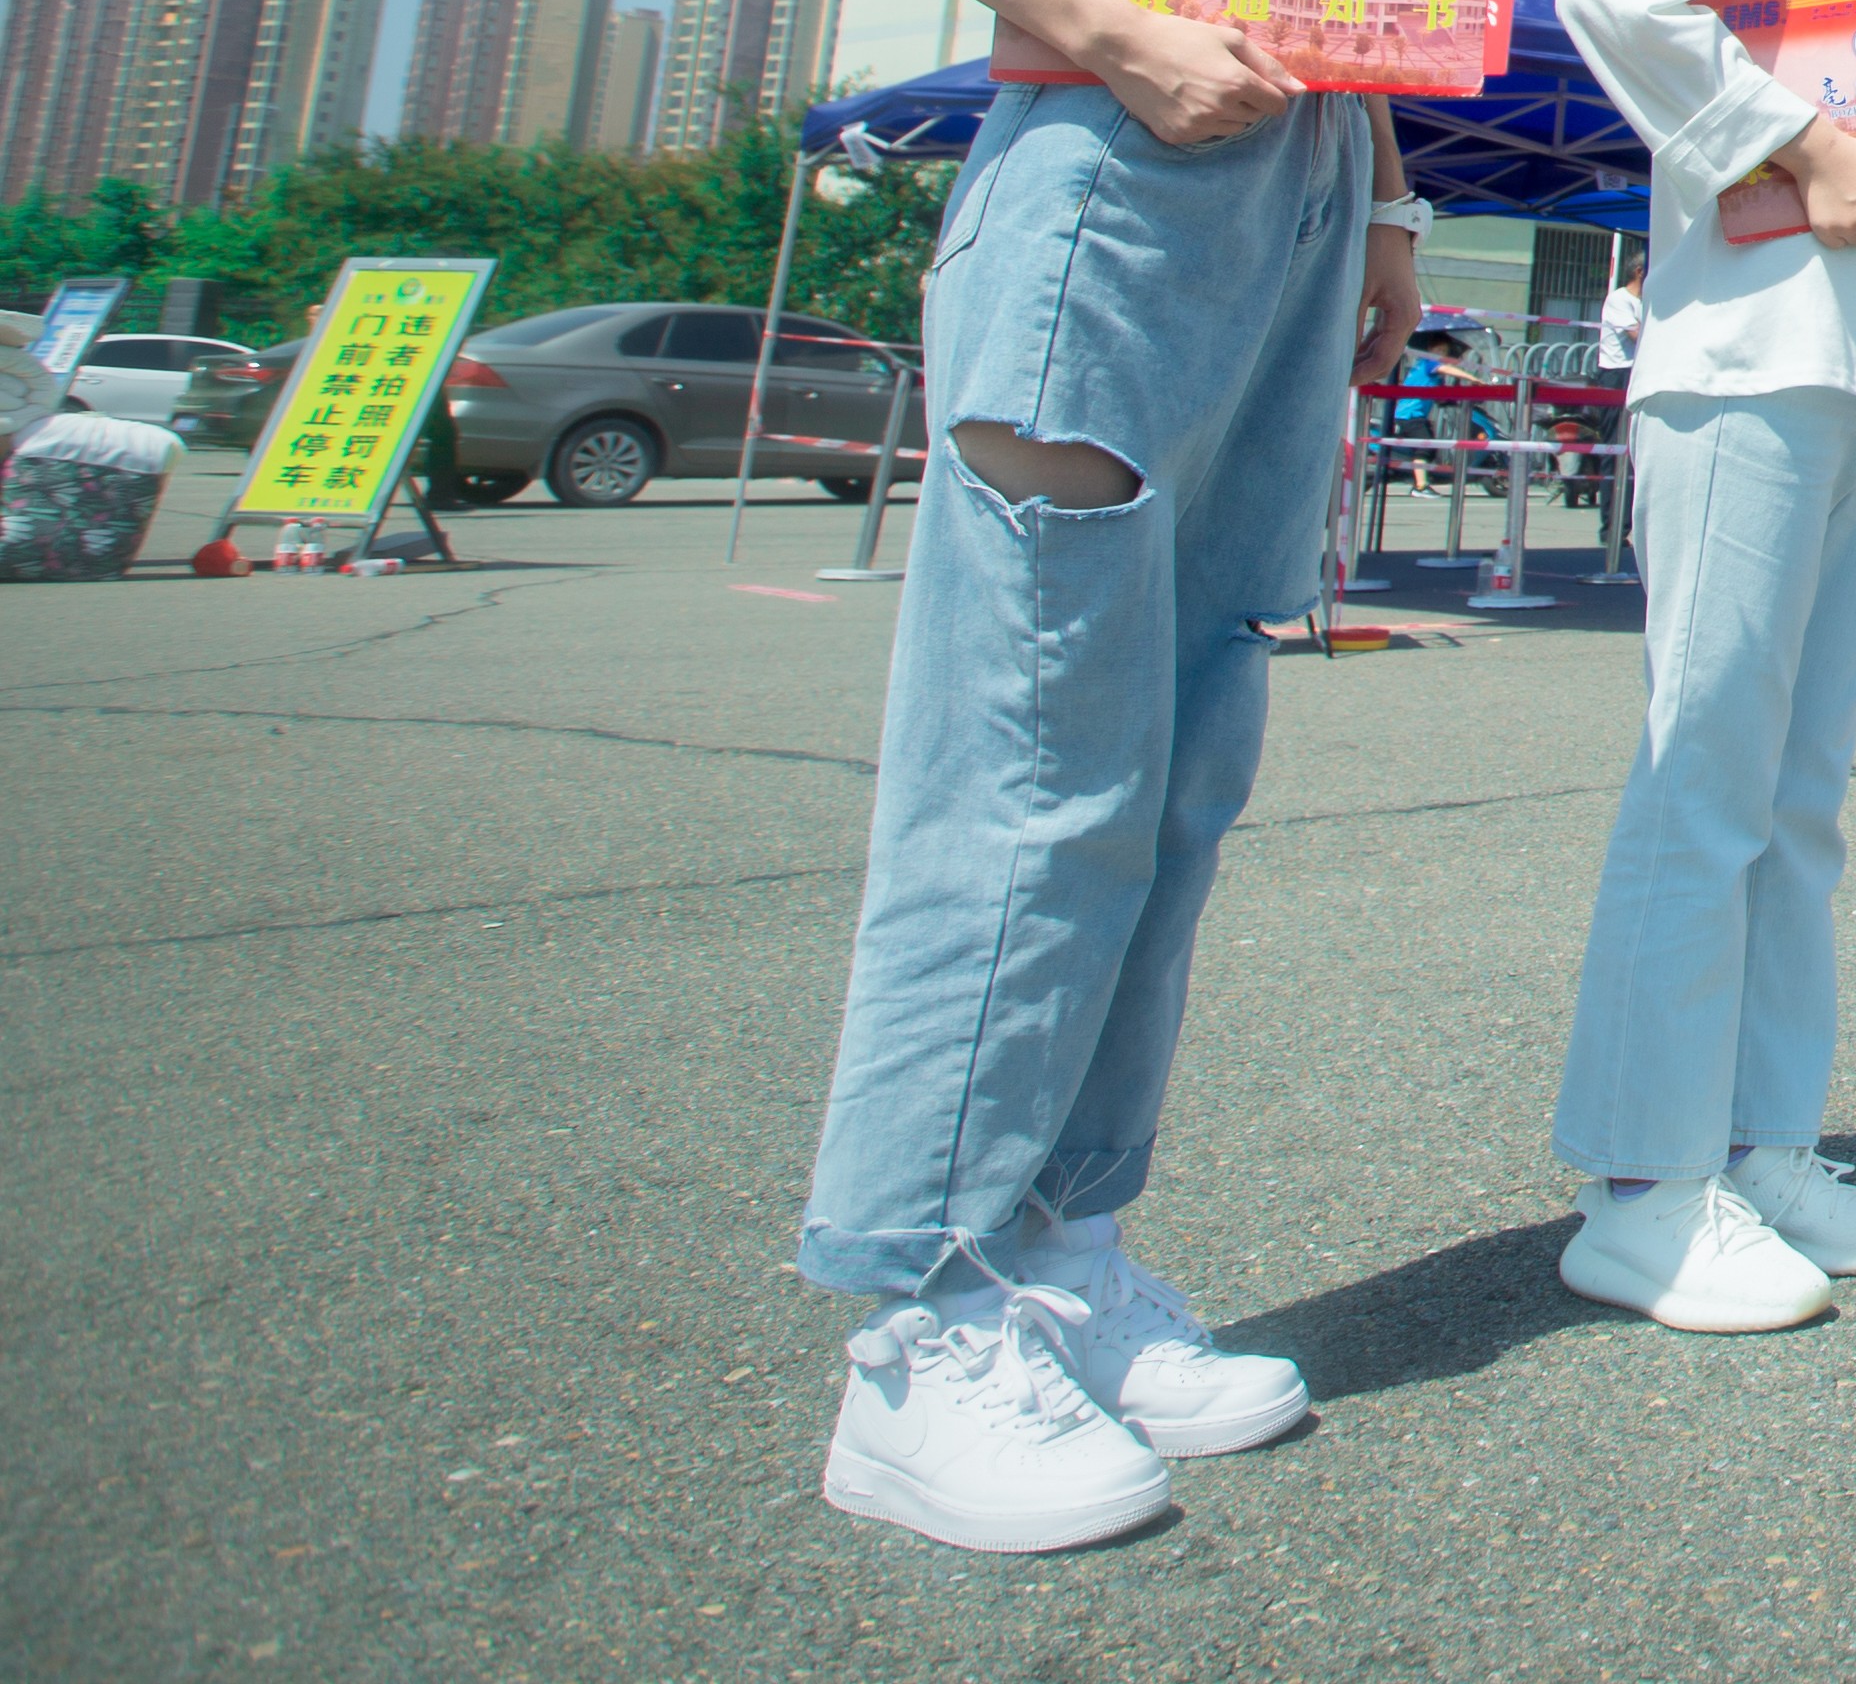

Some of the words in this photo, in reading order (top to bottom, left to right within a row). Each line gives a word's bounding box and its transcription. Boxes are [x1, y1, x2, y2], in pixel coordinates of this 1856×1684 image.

[1723, 0, 1780, 32] EMS
[274, 313, 391, 488] 门前禁止停车
[322, 314, 436, 490] 违者拍照罚款
